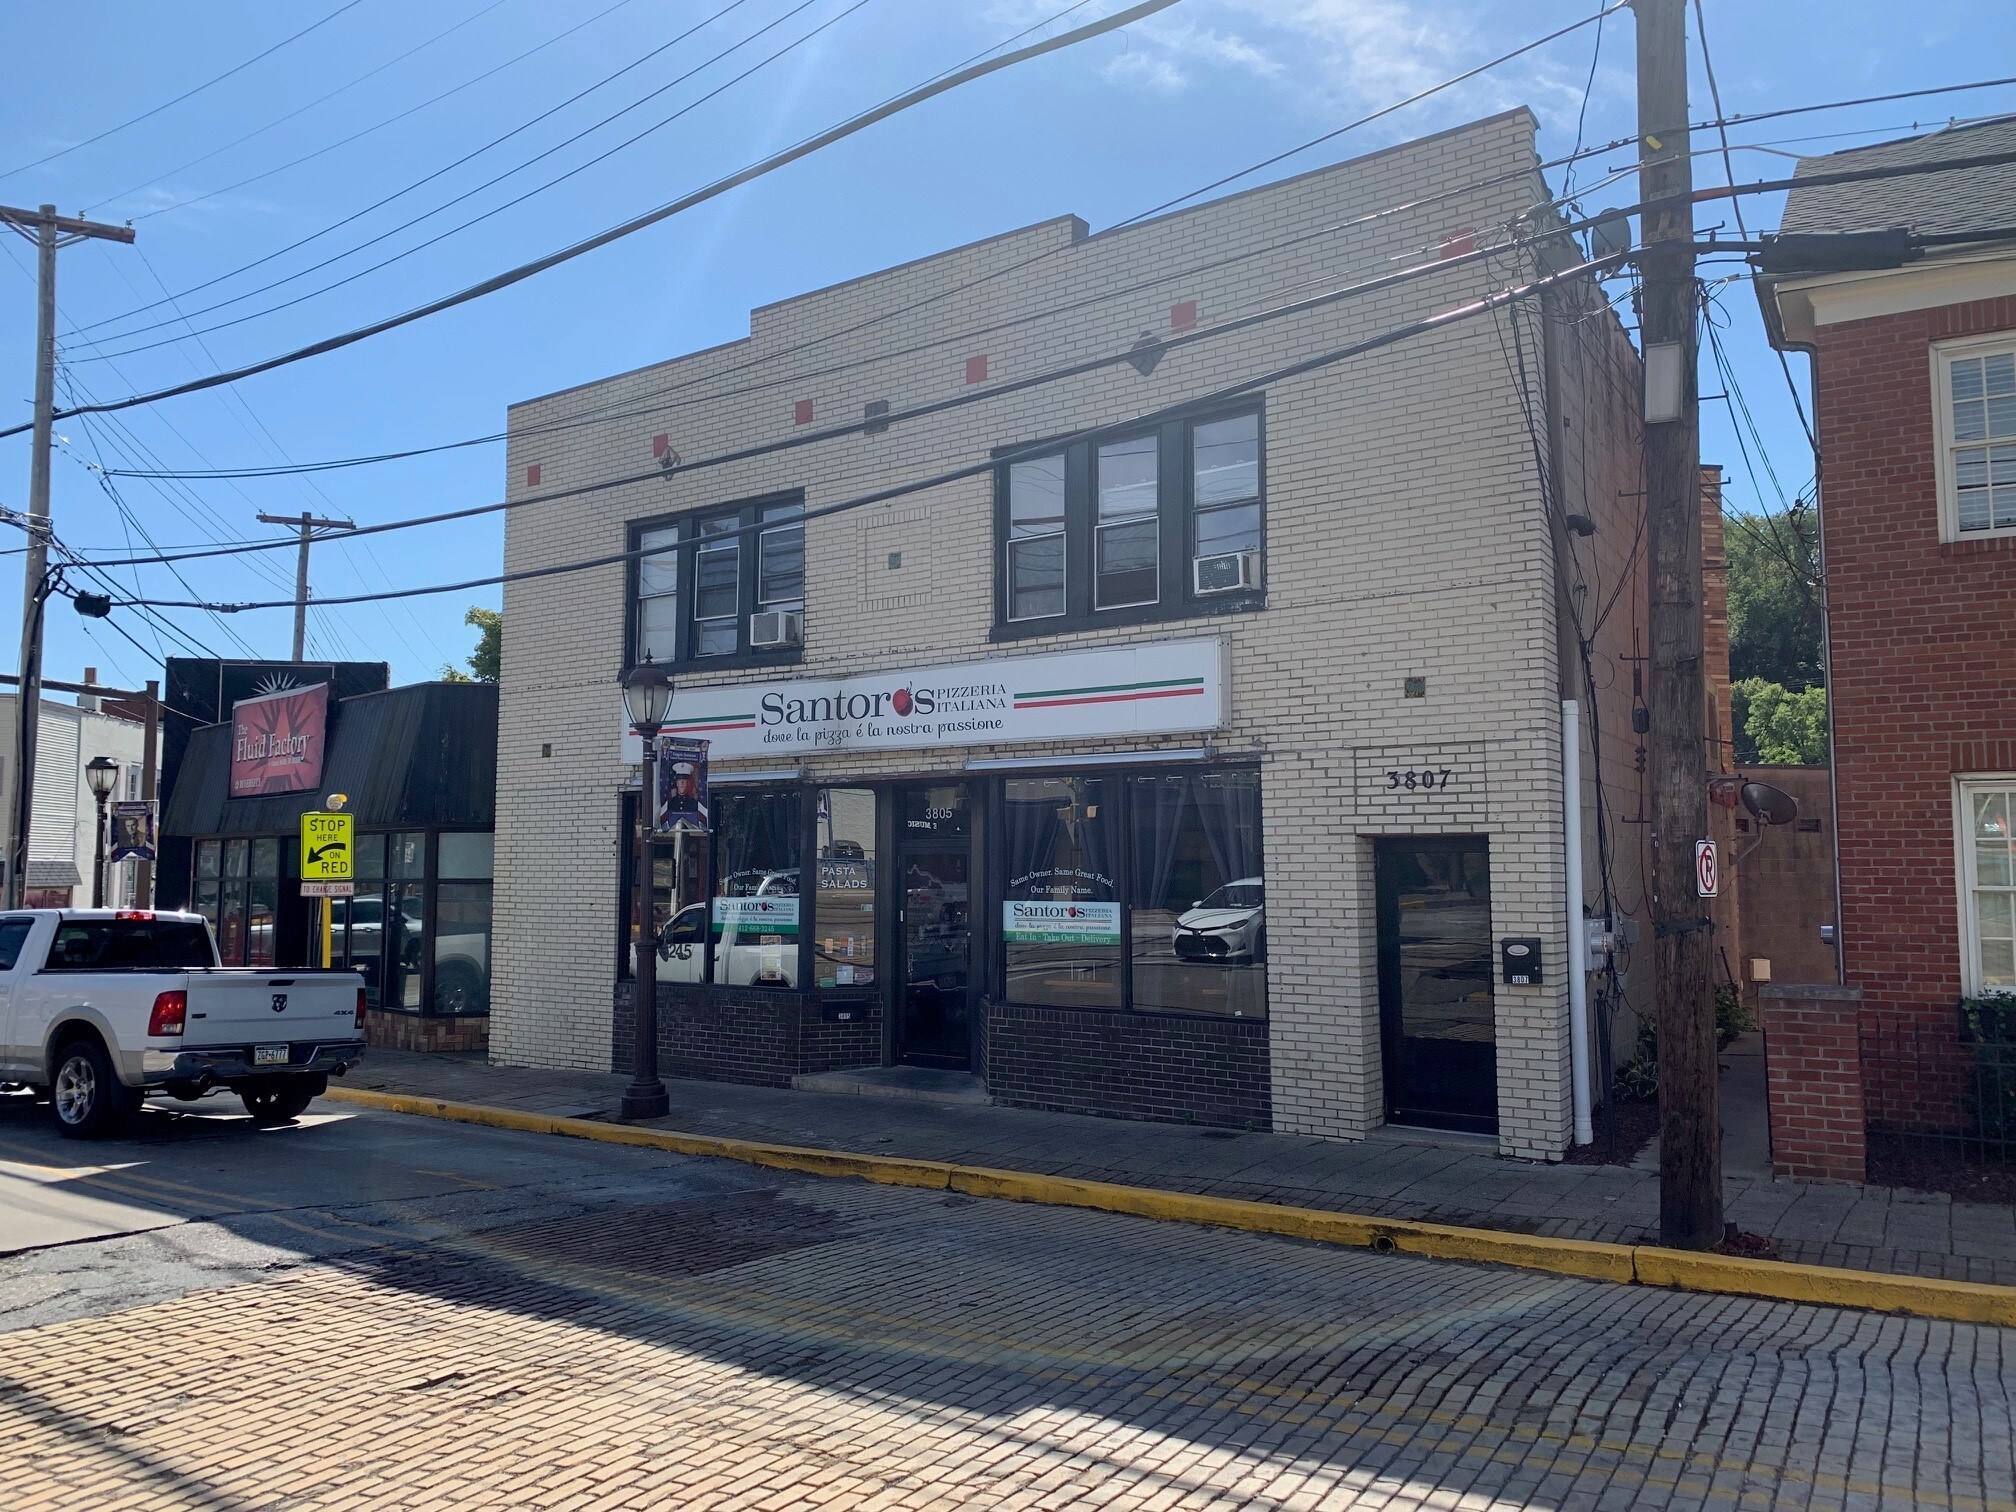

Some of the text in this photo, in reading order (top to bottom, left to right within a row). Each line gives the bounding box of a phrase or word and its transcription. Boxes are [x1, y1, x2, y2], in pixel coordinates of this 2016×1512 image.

[937, 684, 1007, 699] PIZZERIA
[937, 698, 1007, 713] ITALIANA
[238, 724, 248, 735] The
[764, 730, 793, 744] dove
[797, 726, 811, 741] la
[815, 727, 852, 746] pizza
[868, 722, 883, 737] la
[887, 722, 934, 737] nostra
[938, 717, 1004, 738] passione
[236, 732, 310, 761] Fluid Factory
[1386, 769, 1452, 790] 3807
[925, 807, 953, 819] 3805
[310, 819, 346, 832] STOP
[316, 833, 338, 842] HERE
[329, 851, 340, 859] ON
[321, 861, 348, 874] RED
[821, 867, 856, 876] PASTA
[1010, 875, 1029, 887] Same
[1029, 870, 1053, 879] Owner.
[1054, 867, 1074, 876] Same
[1074, 868, 1095, 879] Great
[303, 885, 352, 893] TO CHANGE SIGNAL
[821, 879, 868, 888] SALADS
[1031, 885, 1044, 893] Our
[1045, 885, 1069, 895] Family
[1016, 932, 1111, 944] Eat In Take Out Delivery
